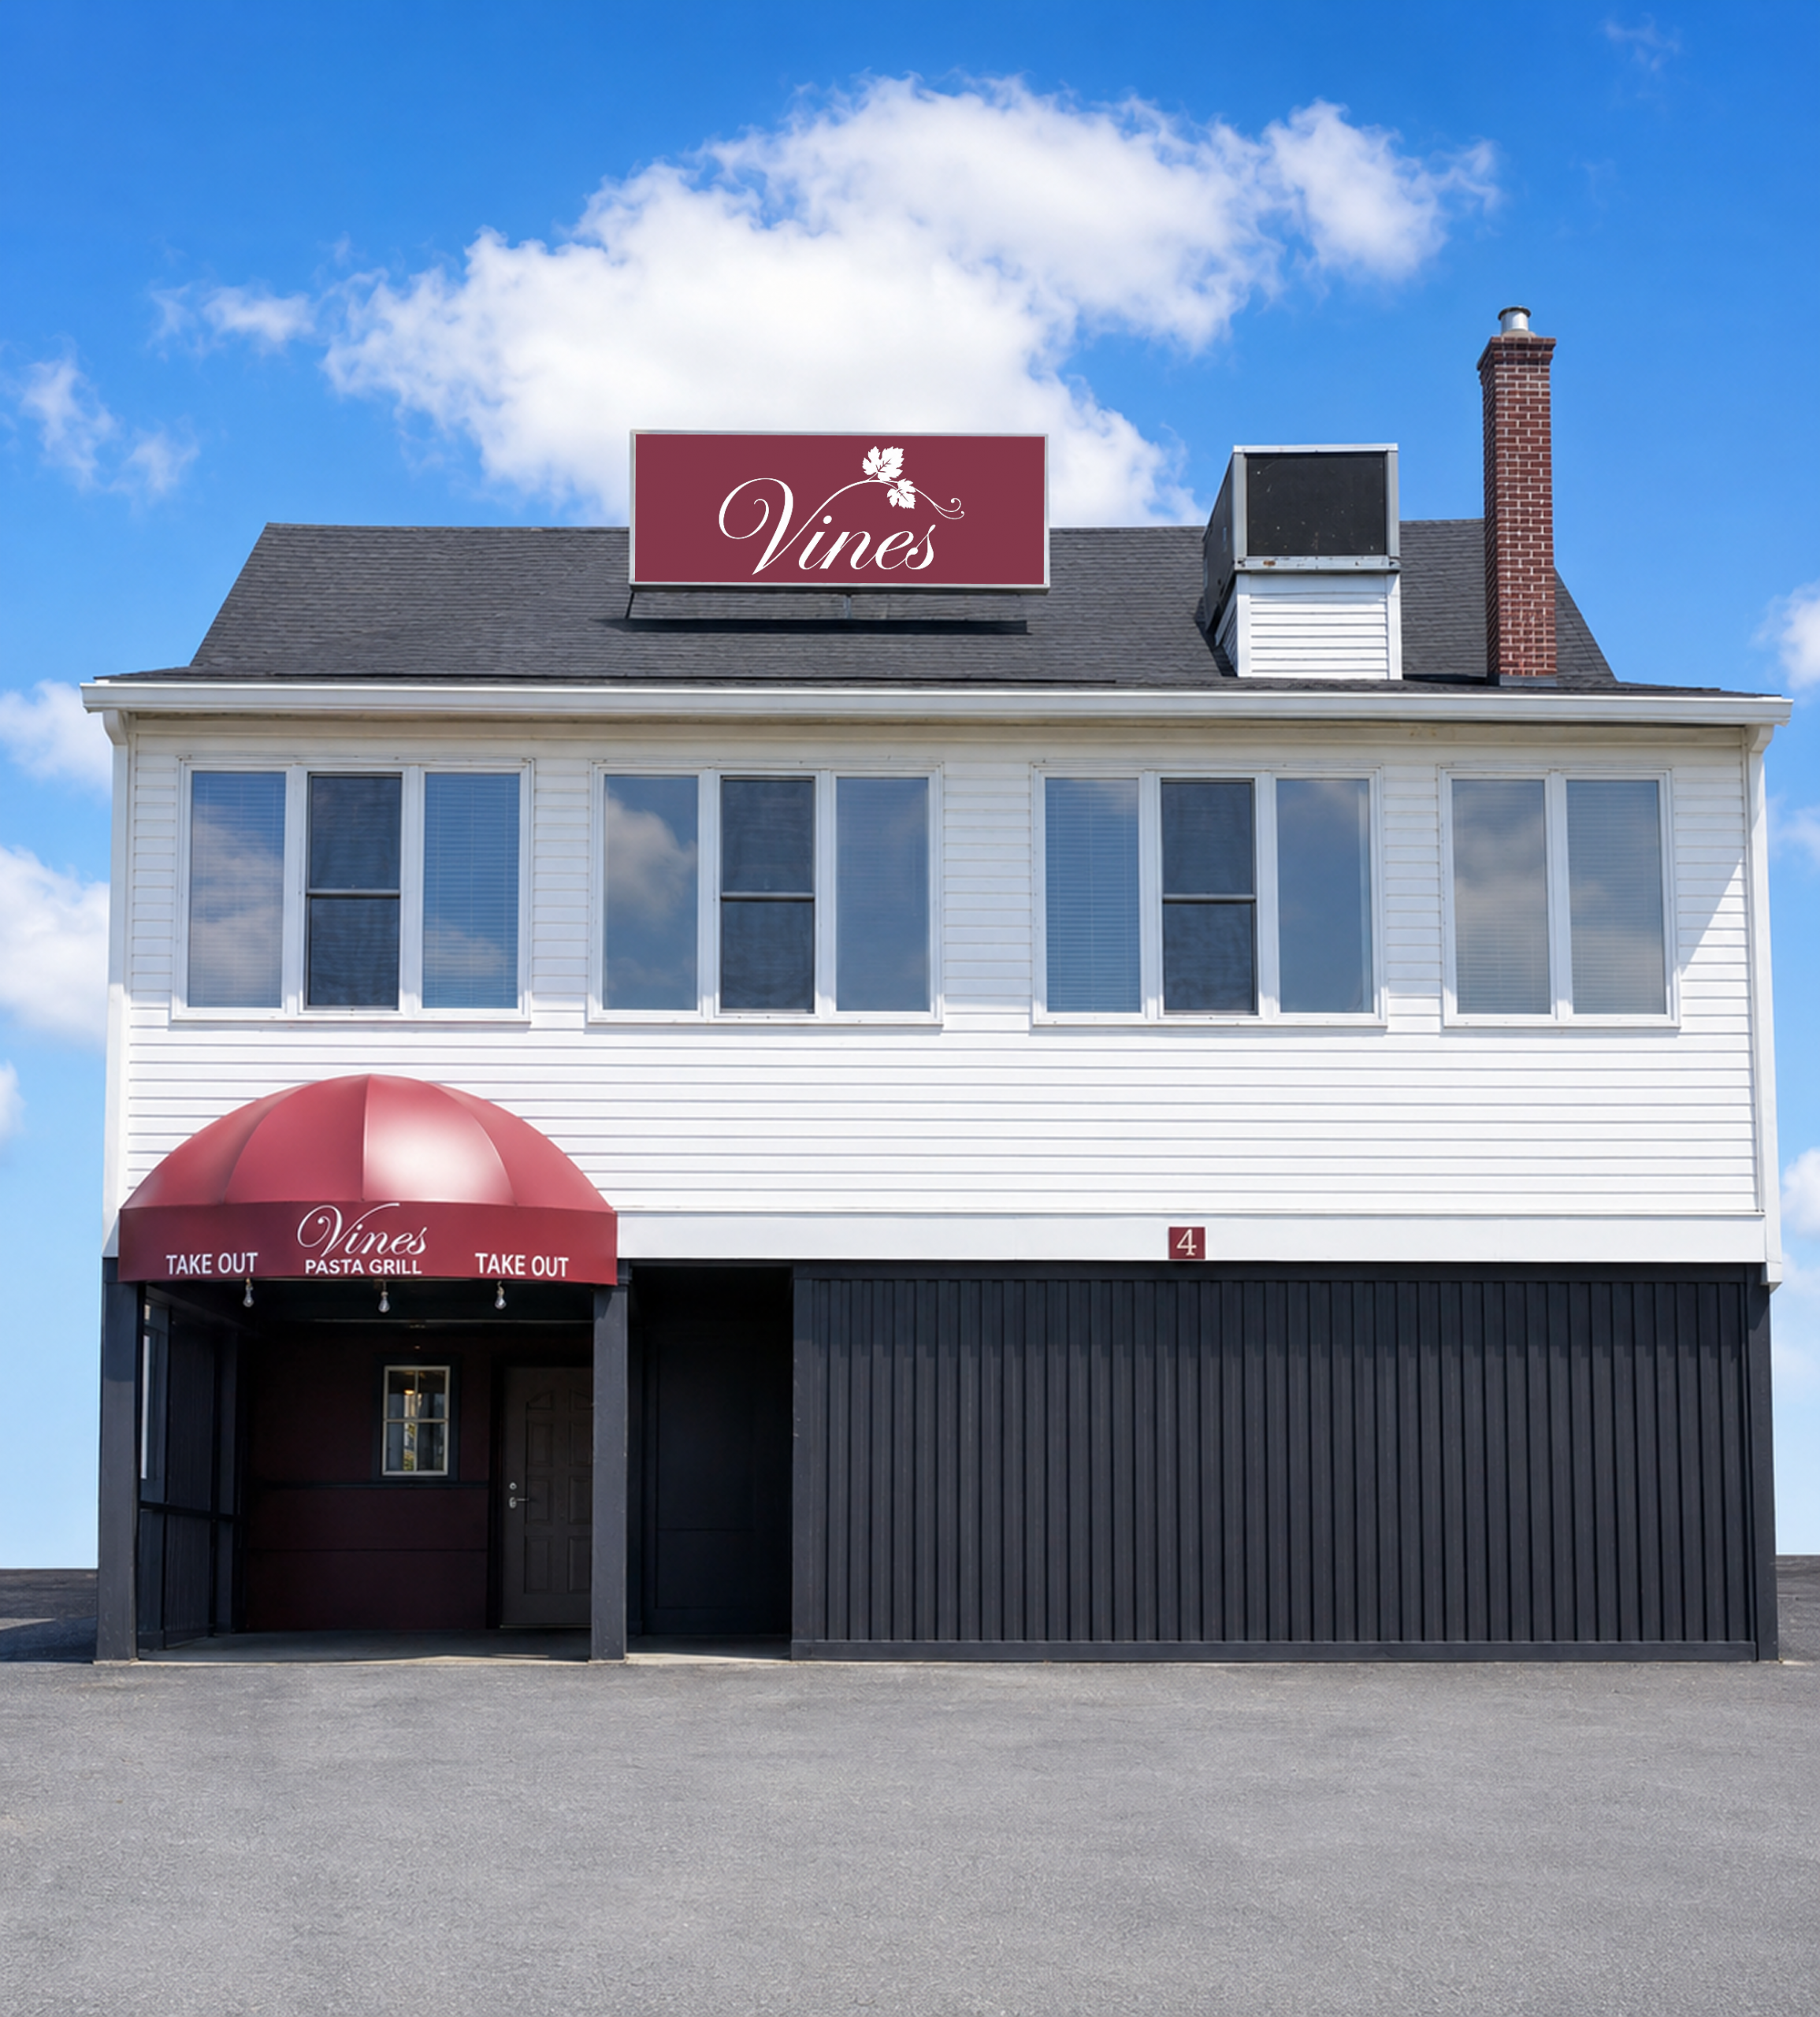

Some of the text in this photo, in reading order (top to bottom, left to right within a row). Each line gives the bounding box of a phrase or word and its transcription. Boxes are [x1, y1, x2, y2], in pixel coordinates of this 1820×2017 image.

[718, 477, 936, 575] Vines
[297, 1202, 428, 1257] Vines
[1176, 1228, 1197, 1256] 4
[165, 1252, 258, 1275] TAKE OUT
[305, 1259, 422, 1275] PASTA GRILL
[474, 1252, 570, 1278] TAKE OUT
